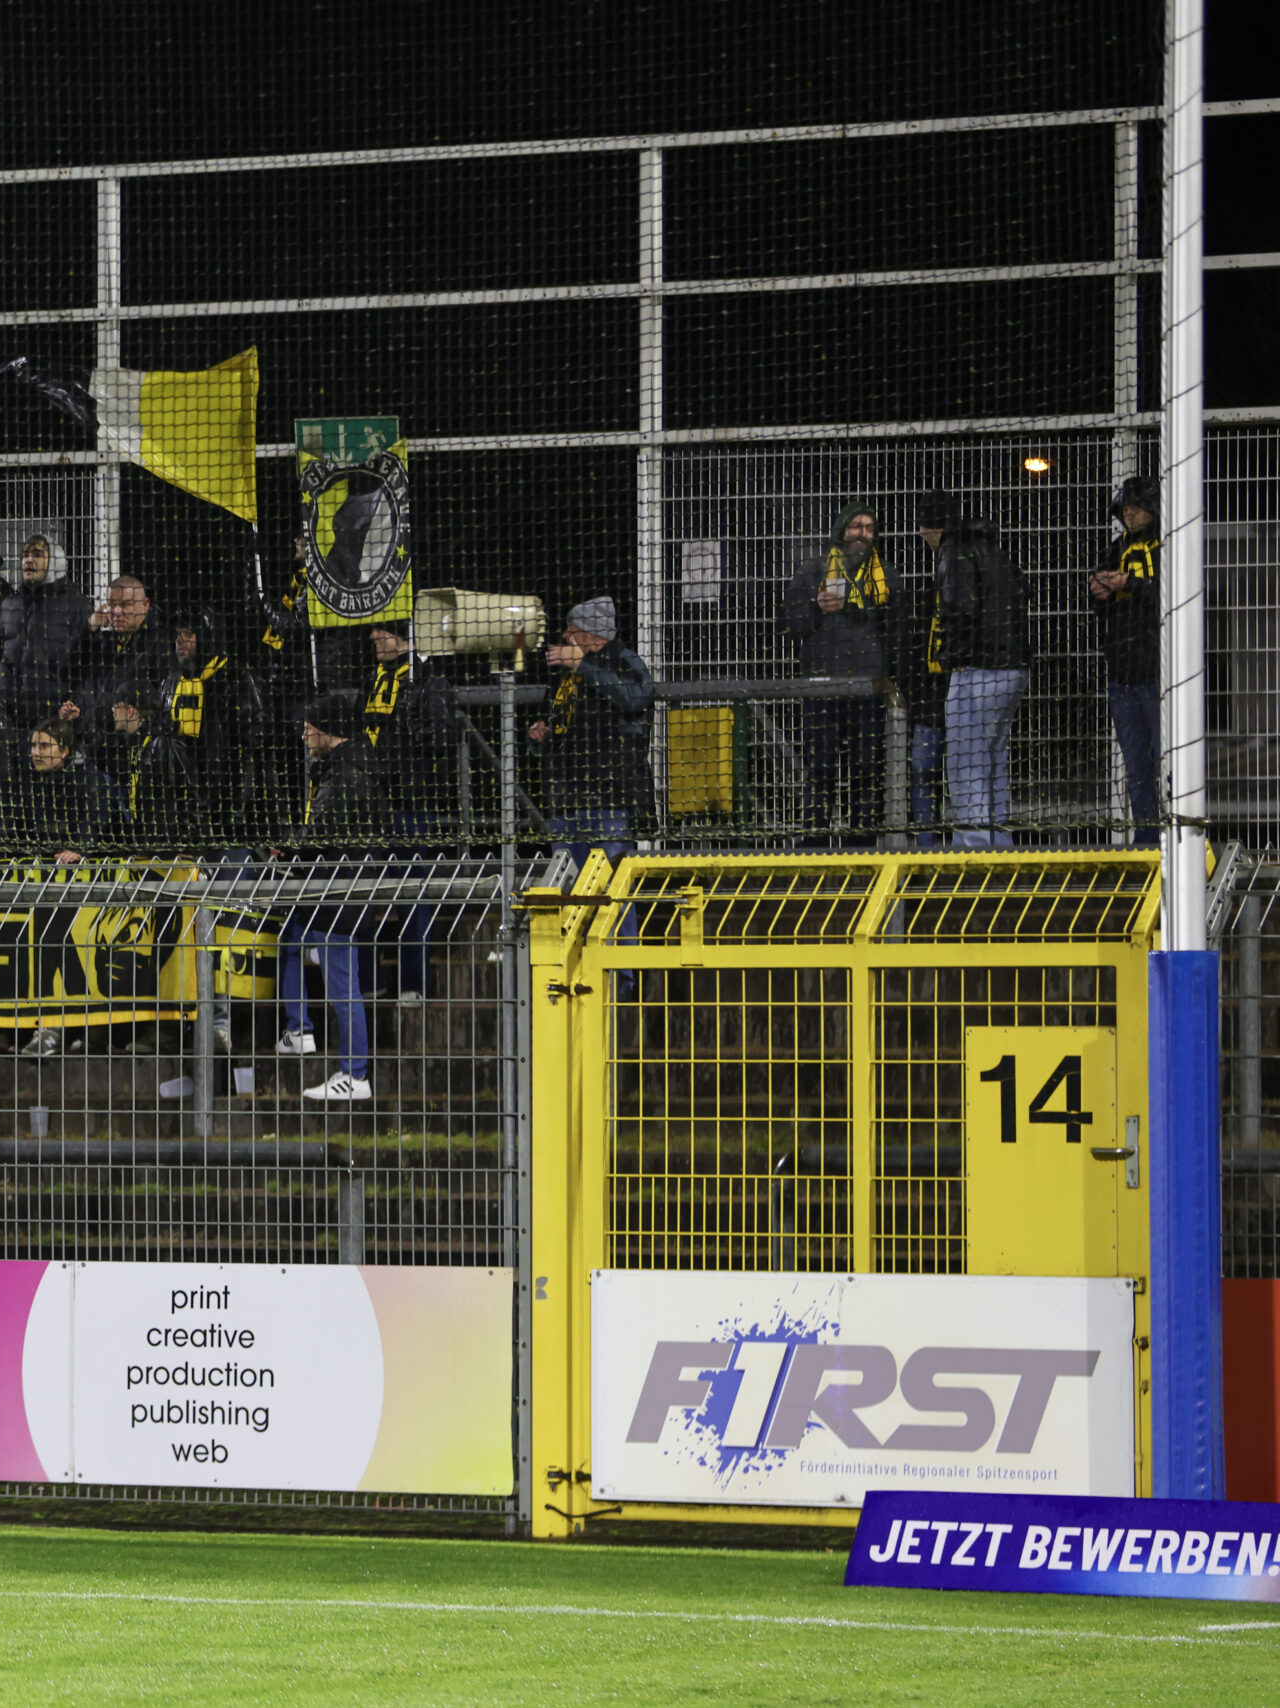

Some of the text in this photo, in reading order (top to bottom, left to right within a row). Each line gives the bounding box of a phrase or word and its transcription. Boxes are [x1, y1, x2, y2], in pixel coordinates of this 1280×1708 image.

[979, 1055, 1093, 1143] 14
[170, 1285, 231, 1314] print
[146, 1323, 255, 1349] creative
[126, 1361, 275, 1389] production
[131, 1399, 270, 1433] publishing
[171, 1439, 229, 1463] web
[799, 1461, 1059, 1482] Förderinitiative Regionaler Spitzensport
[869, 1520, 1280, 1576] JETZT BEWERBEN!
